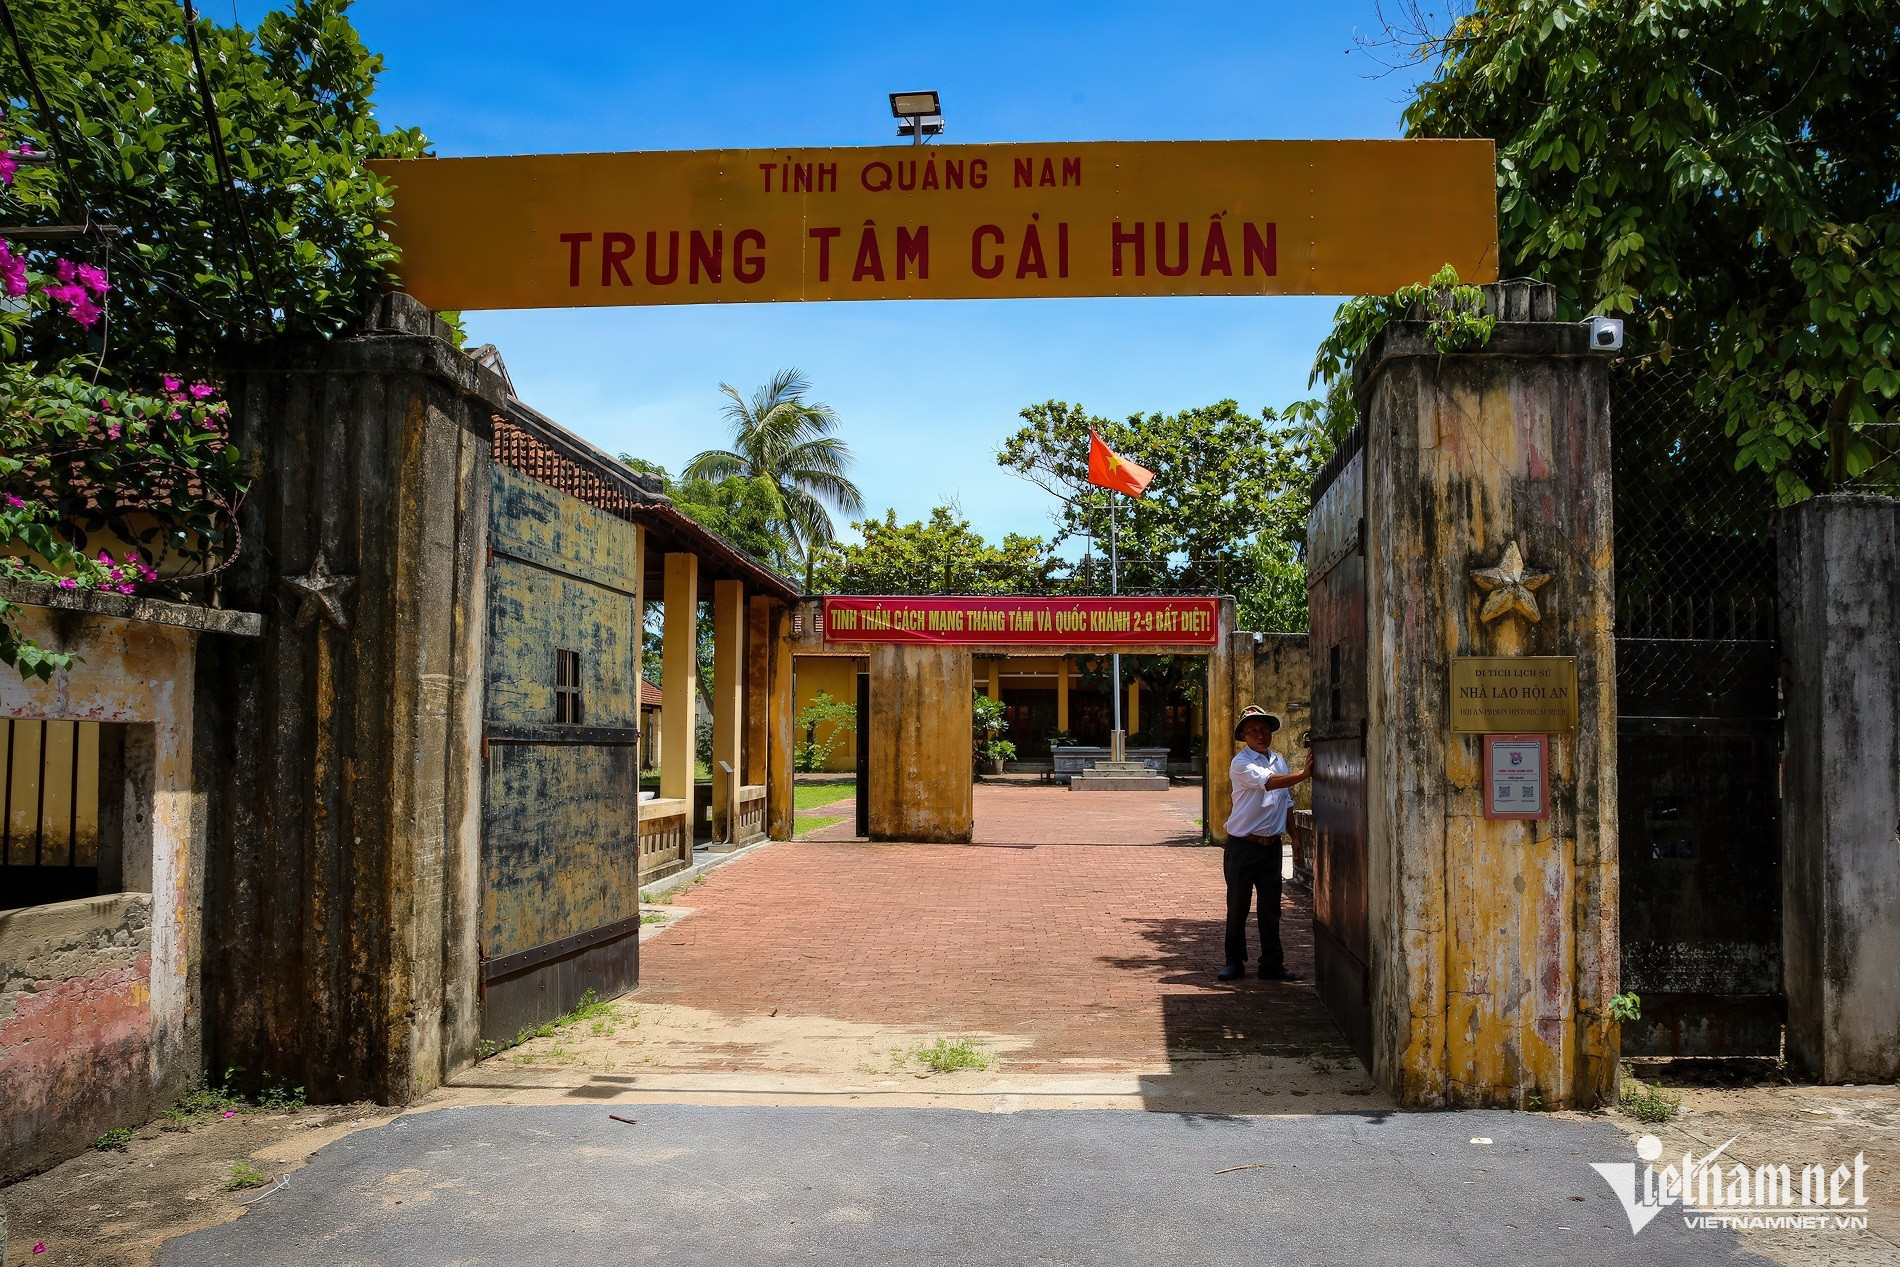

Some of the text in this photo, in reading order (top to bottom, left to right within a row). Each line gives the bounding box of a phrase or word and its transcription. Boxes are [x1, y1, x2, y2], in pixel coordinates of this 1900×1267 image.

[759, 151, 1081, 193] TỈNH QUẢNG NAM
[560, 209, 1277, 287] TRUNG TÂM CẢI HUẤN
[831, 602, 1211, 637] TINH THẦN CÁCH MẠNG THÁNG TÁM VÀ QUỐC KHÁNH 2-9 BẤT DIỆT!
[1475, 669, 1485, 677] DI
[1488, 667, 1511, 677] TÍCH
[1514, 669, 1536, 678] LỊCH
[1460, 684, 1569, 701] NHÀ LAO HỘI AN
